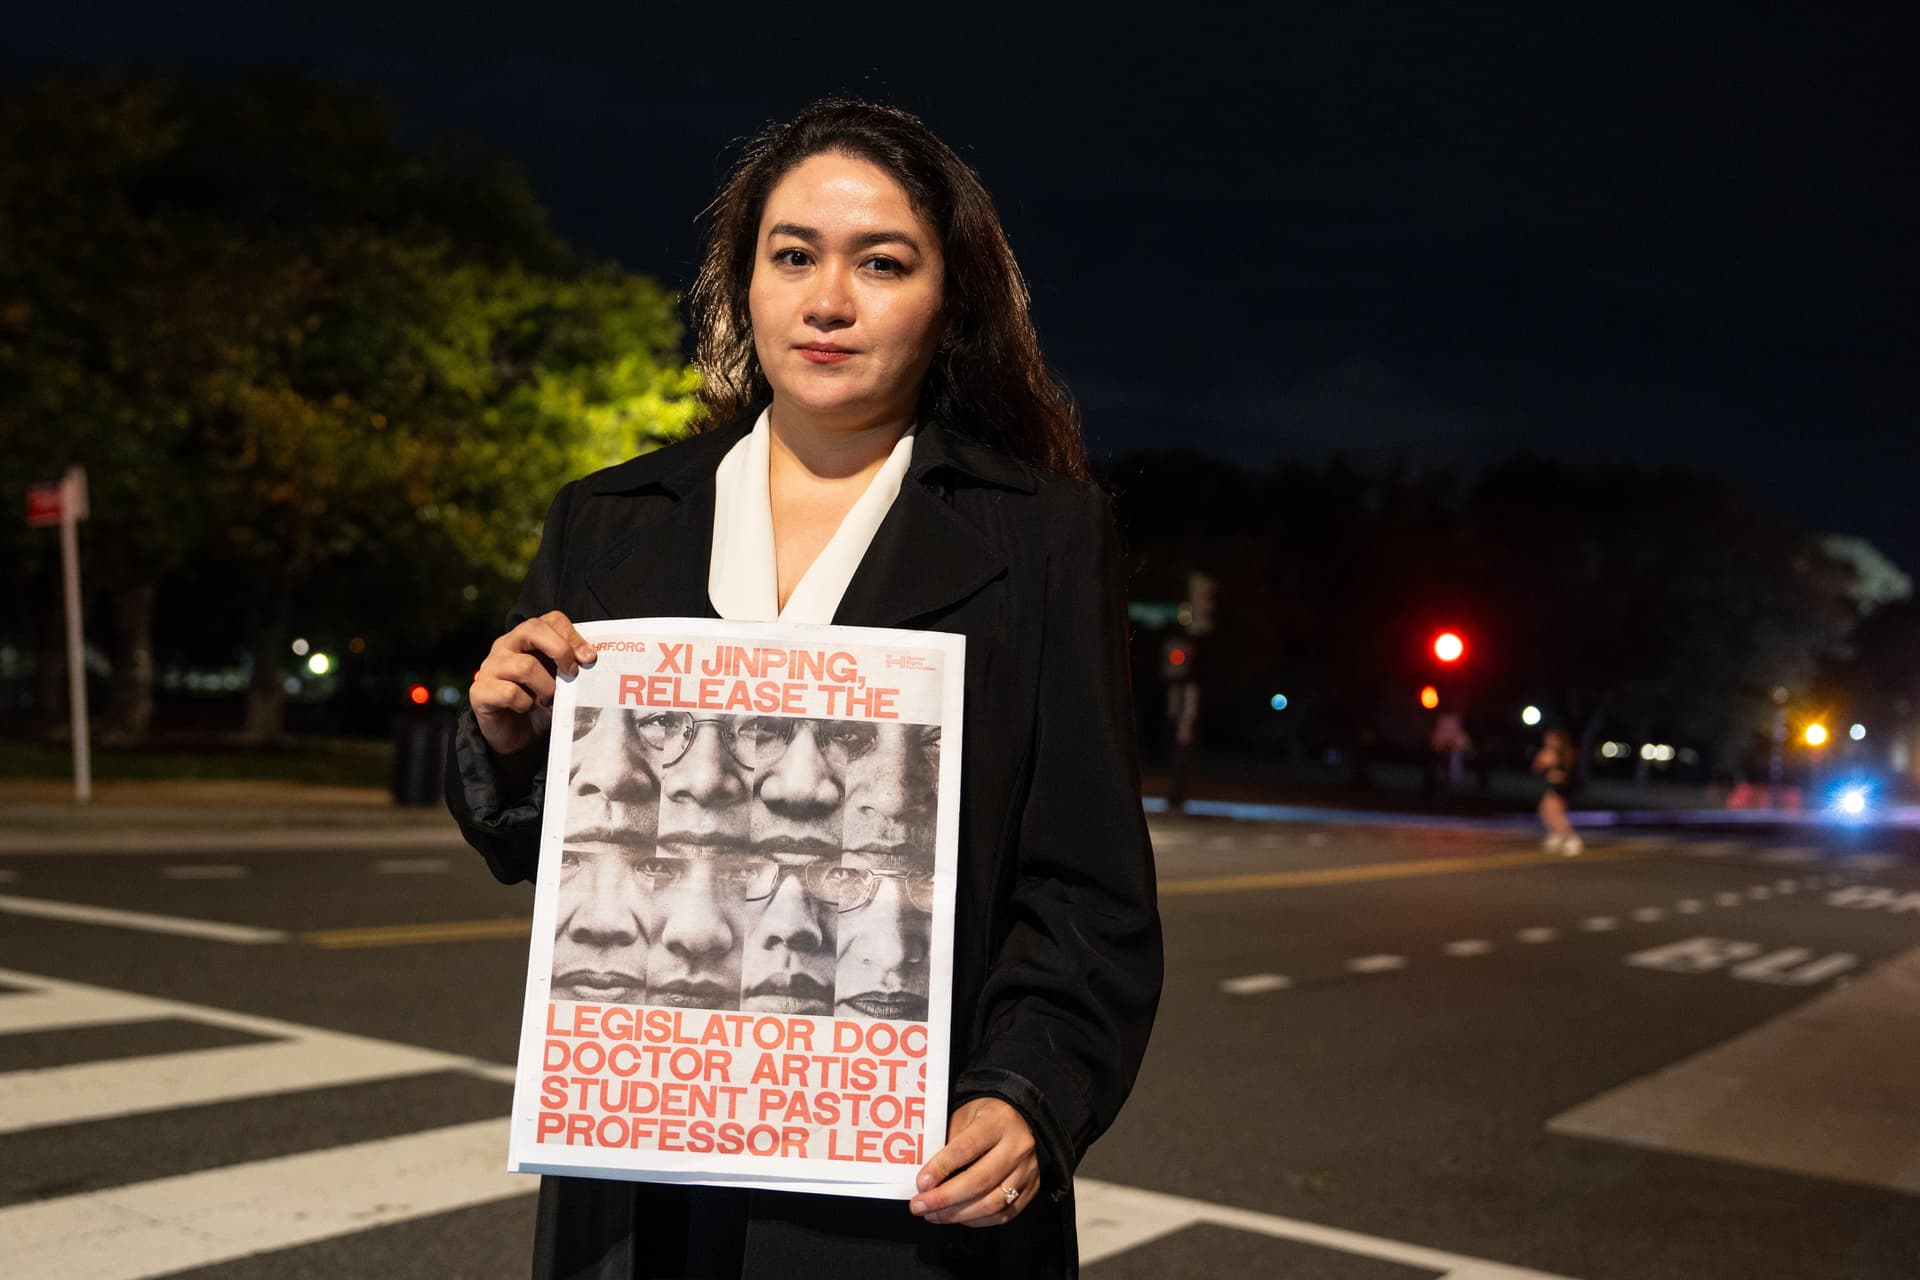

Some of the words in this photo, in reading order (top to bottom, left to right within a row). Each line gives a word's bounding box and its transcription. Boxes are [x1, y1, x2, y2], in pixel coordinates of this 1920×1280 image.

[656, 642, 693, 675] XI
[701, 645, 866, 690] JINPING,
[618, 674, 808, 715] RELEASE
[818, 684, 901, 719] THE
[546, 1003, 815, 1053] LEGISLATOR
[833, 1021, 928, 1059] DOC
[543, 1039, 732, 1083] DOCTOR
[751, 1052, 908, 1093] ARTIST
[540, 1075, 748, 1120] STUDENT
[536, 1111, 810, 1159] PROFESSOR
[828, 1128, 924, 1166] LEGI
